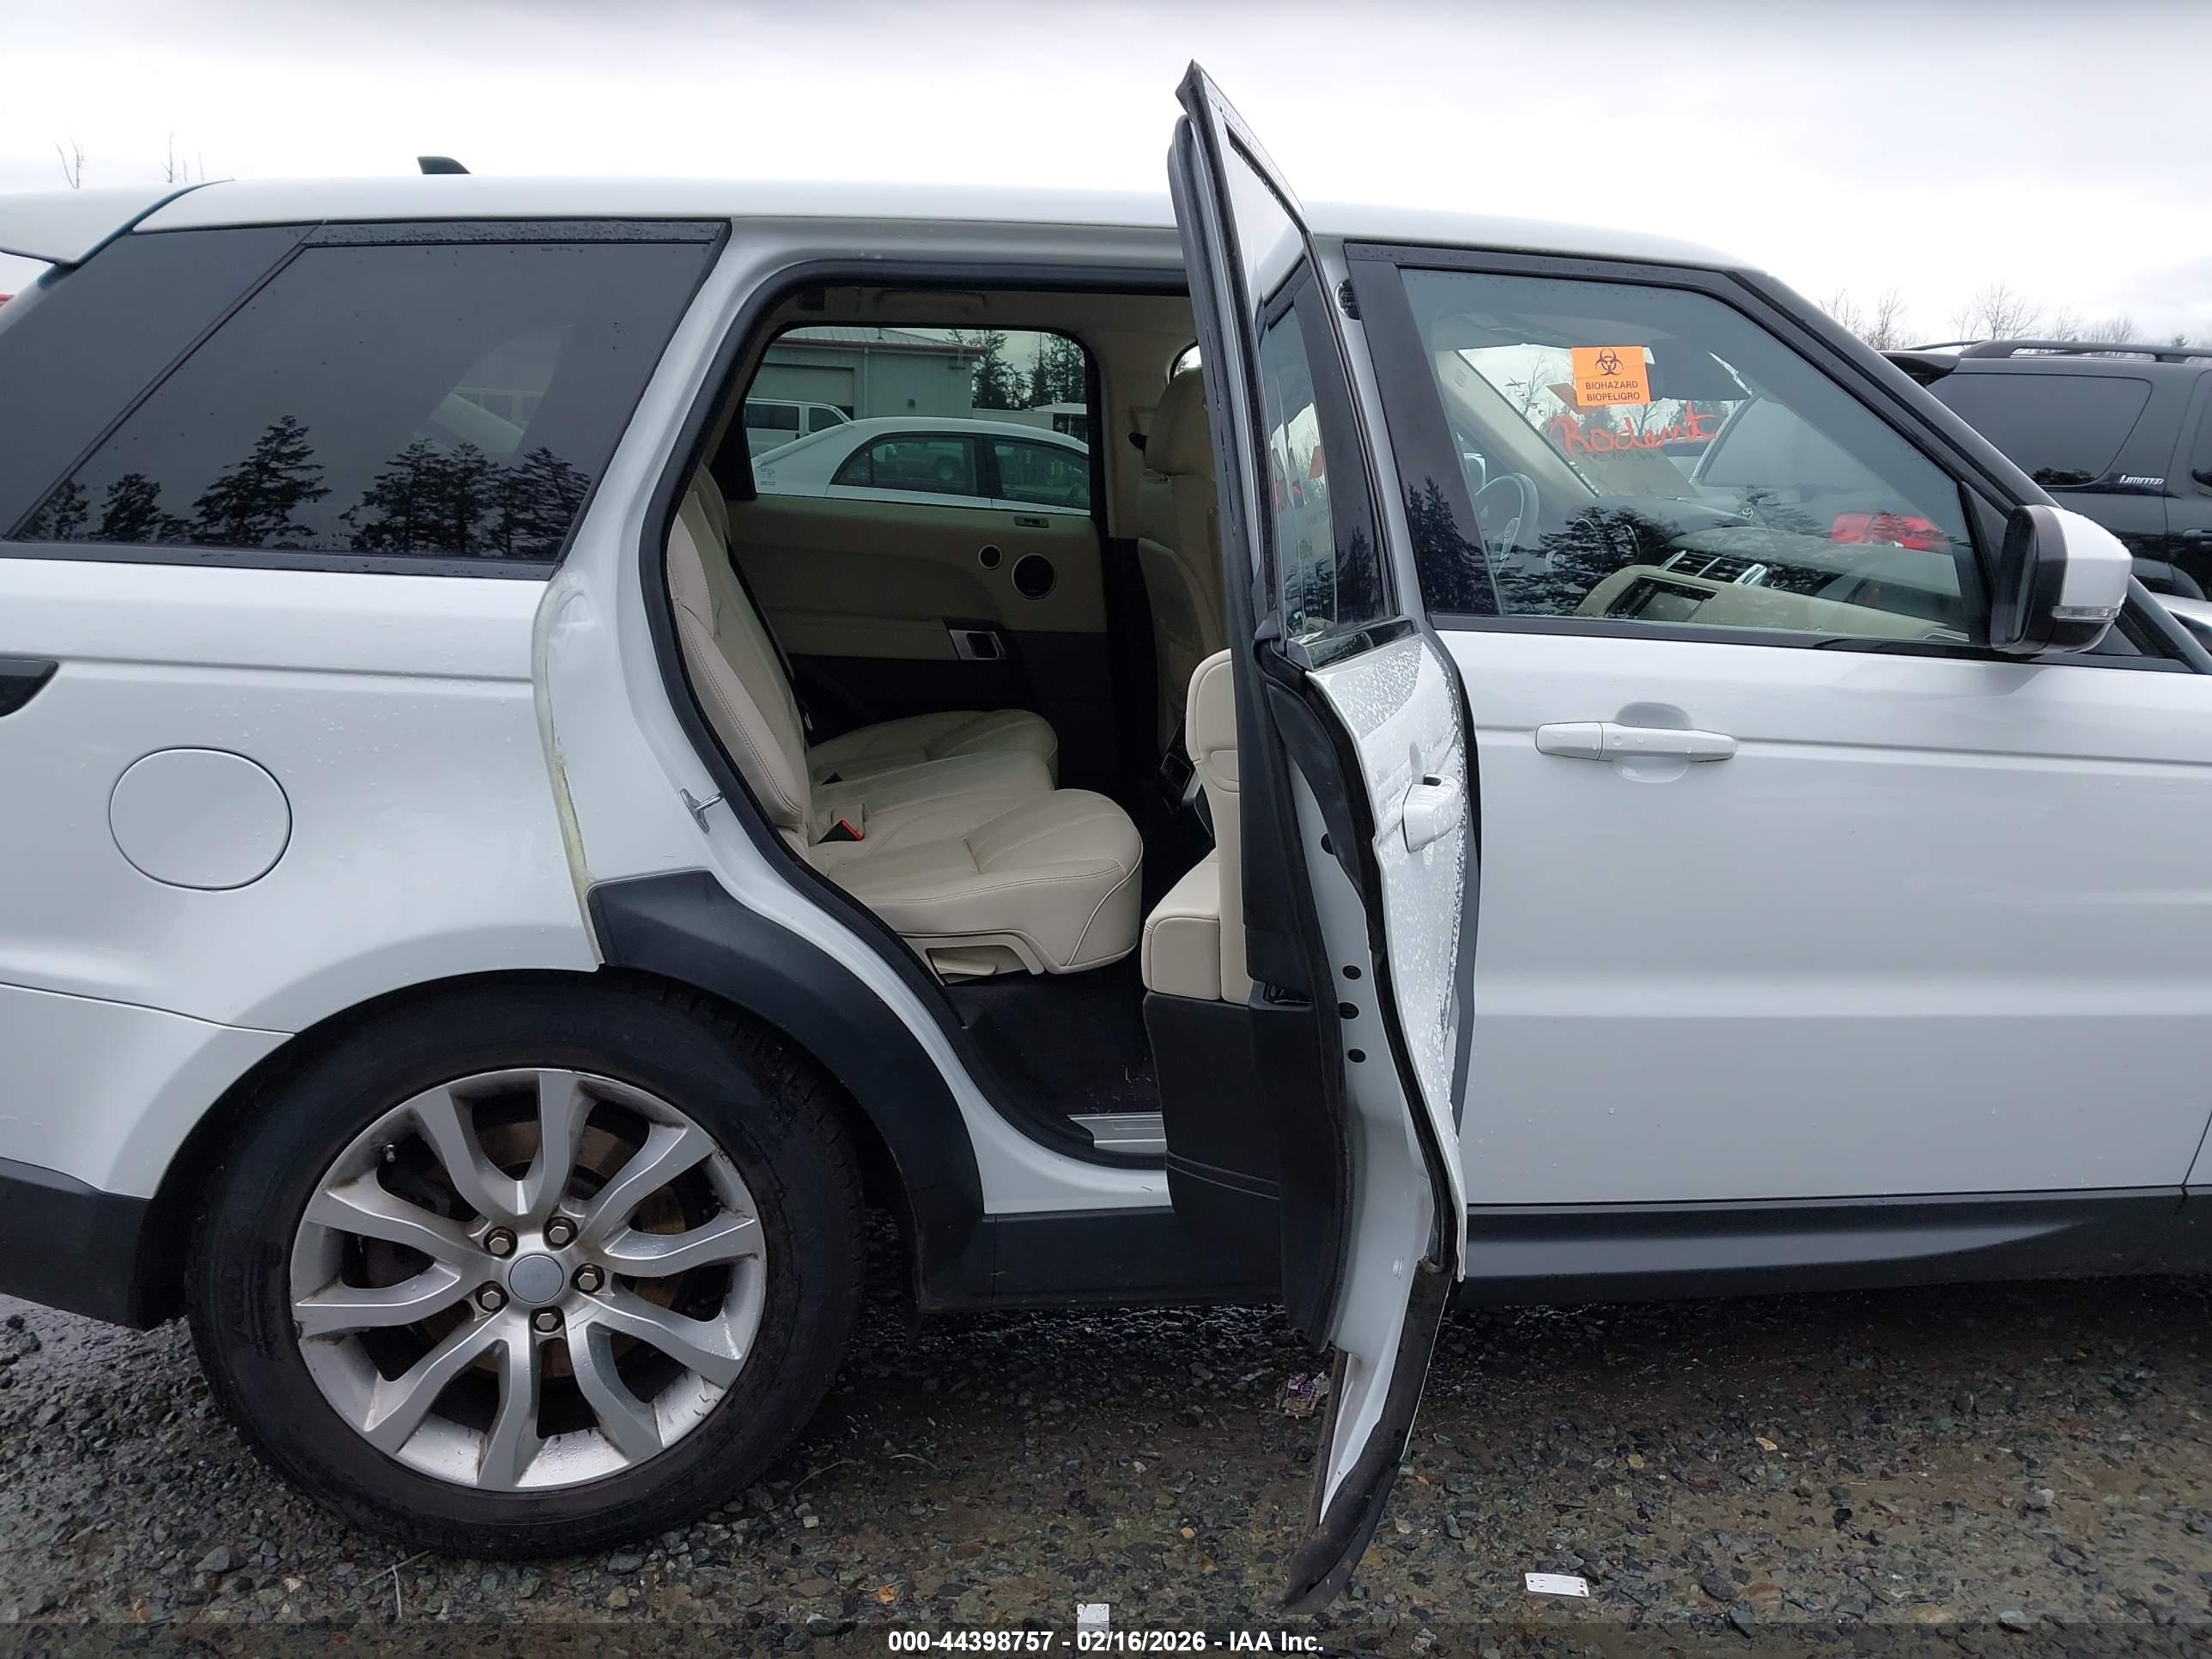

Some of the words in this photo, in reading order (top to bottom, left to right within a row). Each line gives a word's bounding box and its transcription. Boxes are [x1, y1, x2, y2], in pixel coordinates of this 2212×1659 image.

[1585, 380, 1638, 390] BIOHAZARD
[1586, 392, 1640, 402] BIOPELIGRO
[1548, 401, 1717, 457] Rodent
